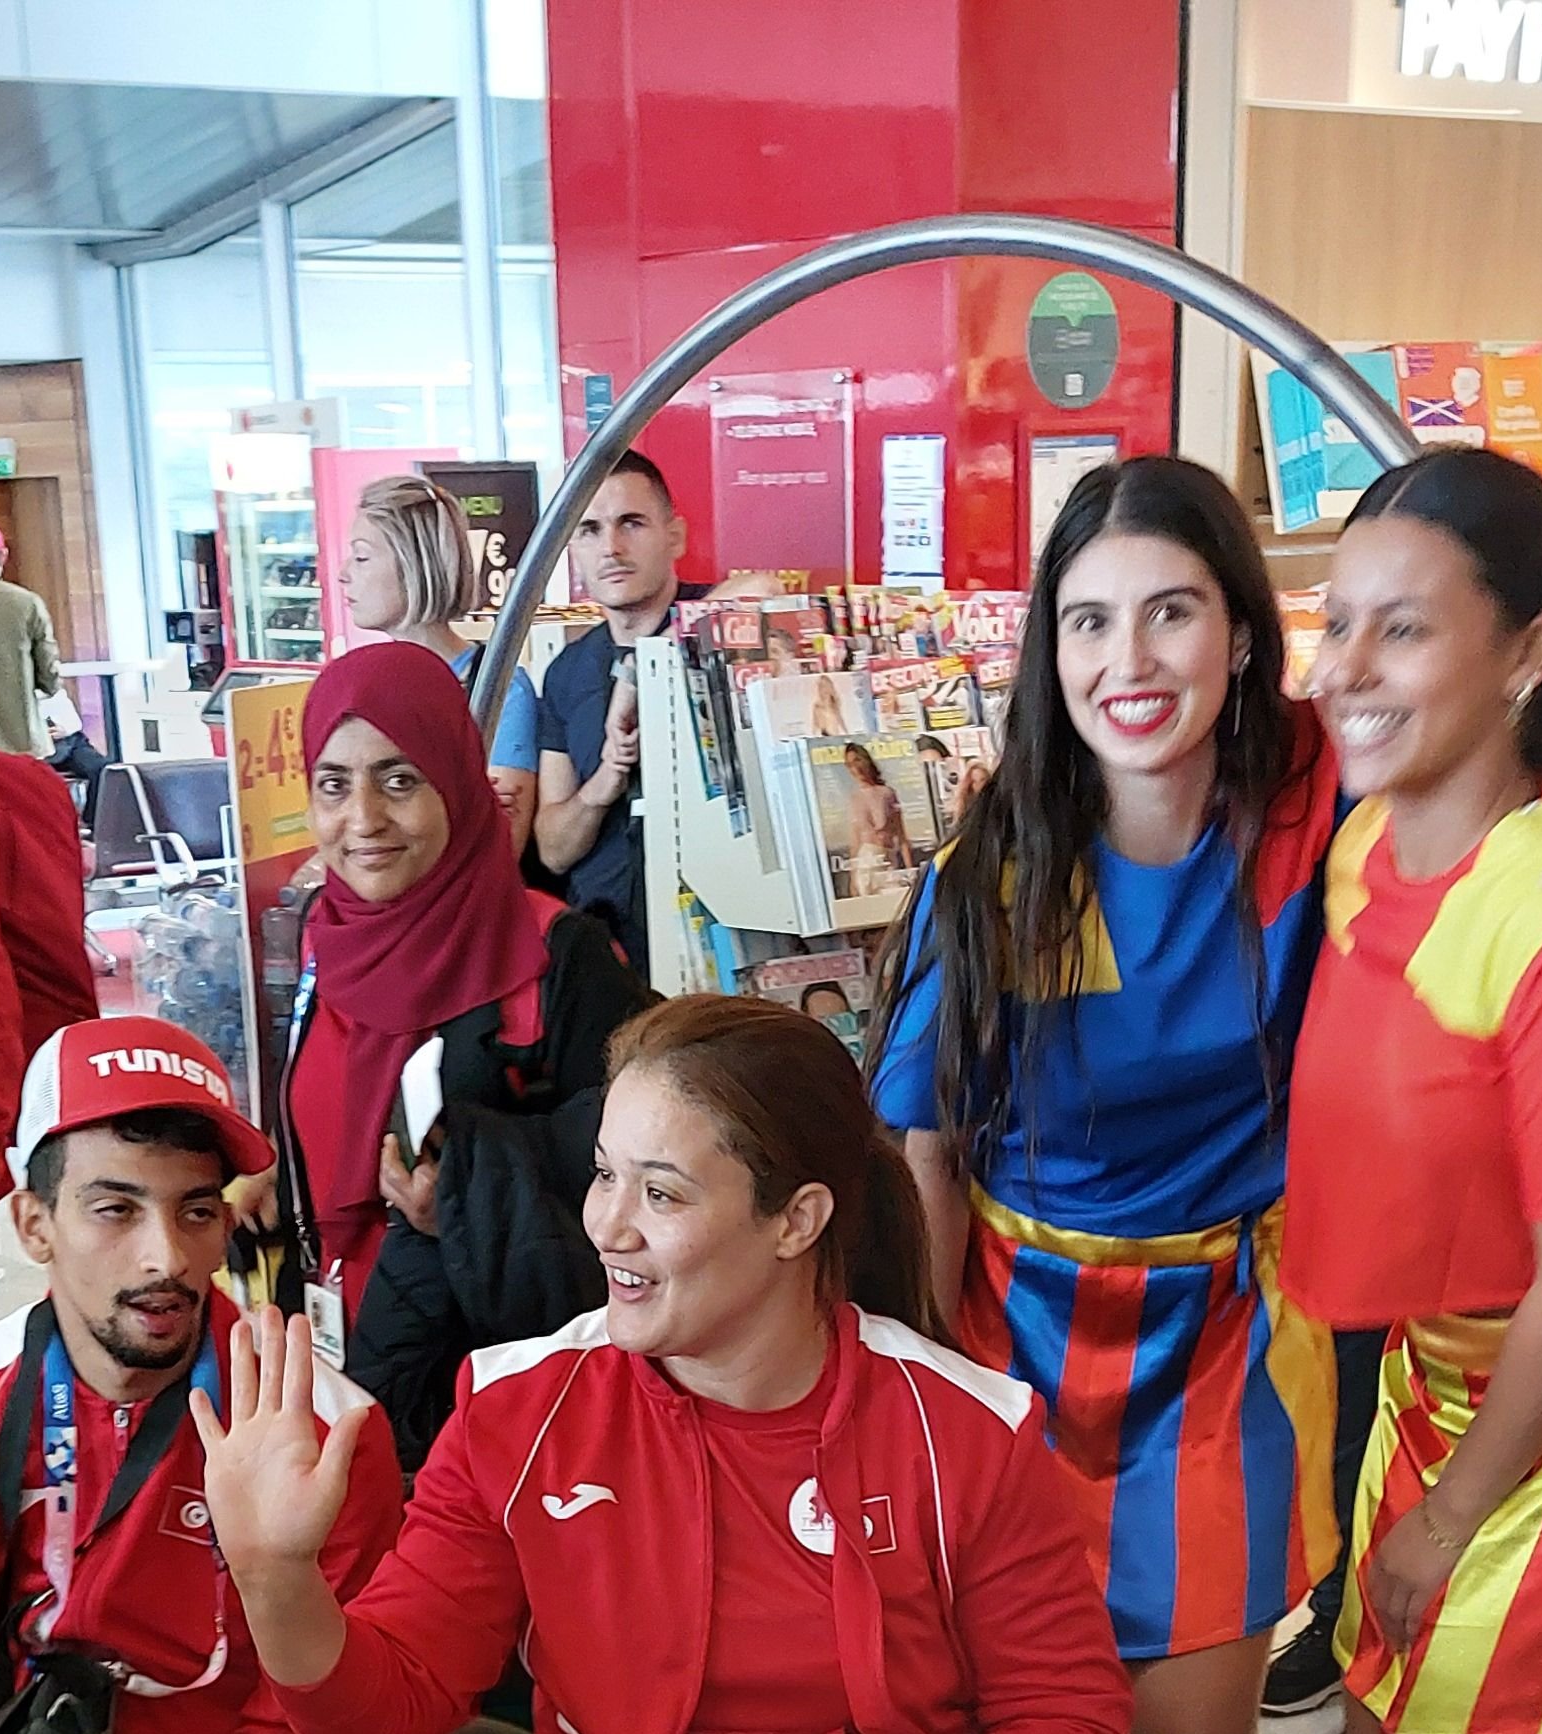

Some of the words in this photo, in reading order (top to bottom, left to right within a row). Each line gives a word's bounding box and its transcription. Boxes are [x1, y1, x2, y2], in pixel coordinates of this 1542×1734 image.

[1400, 0, 1525, 83] PAY
[952, 603, 1006, 642] Voici
[87, 1048, 230, 1107] TUNISIA
